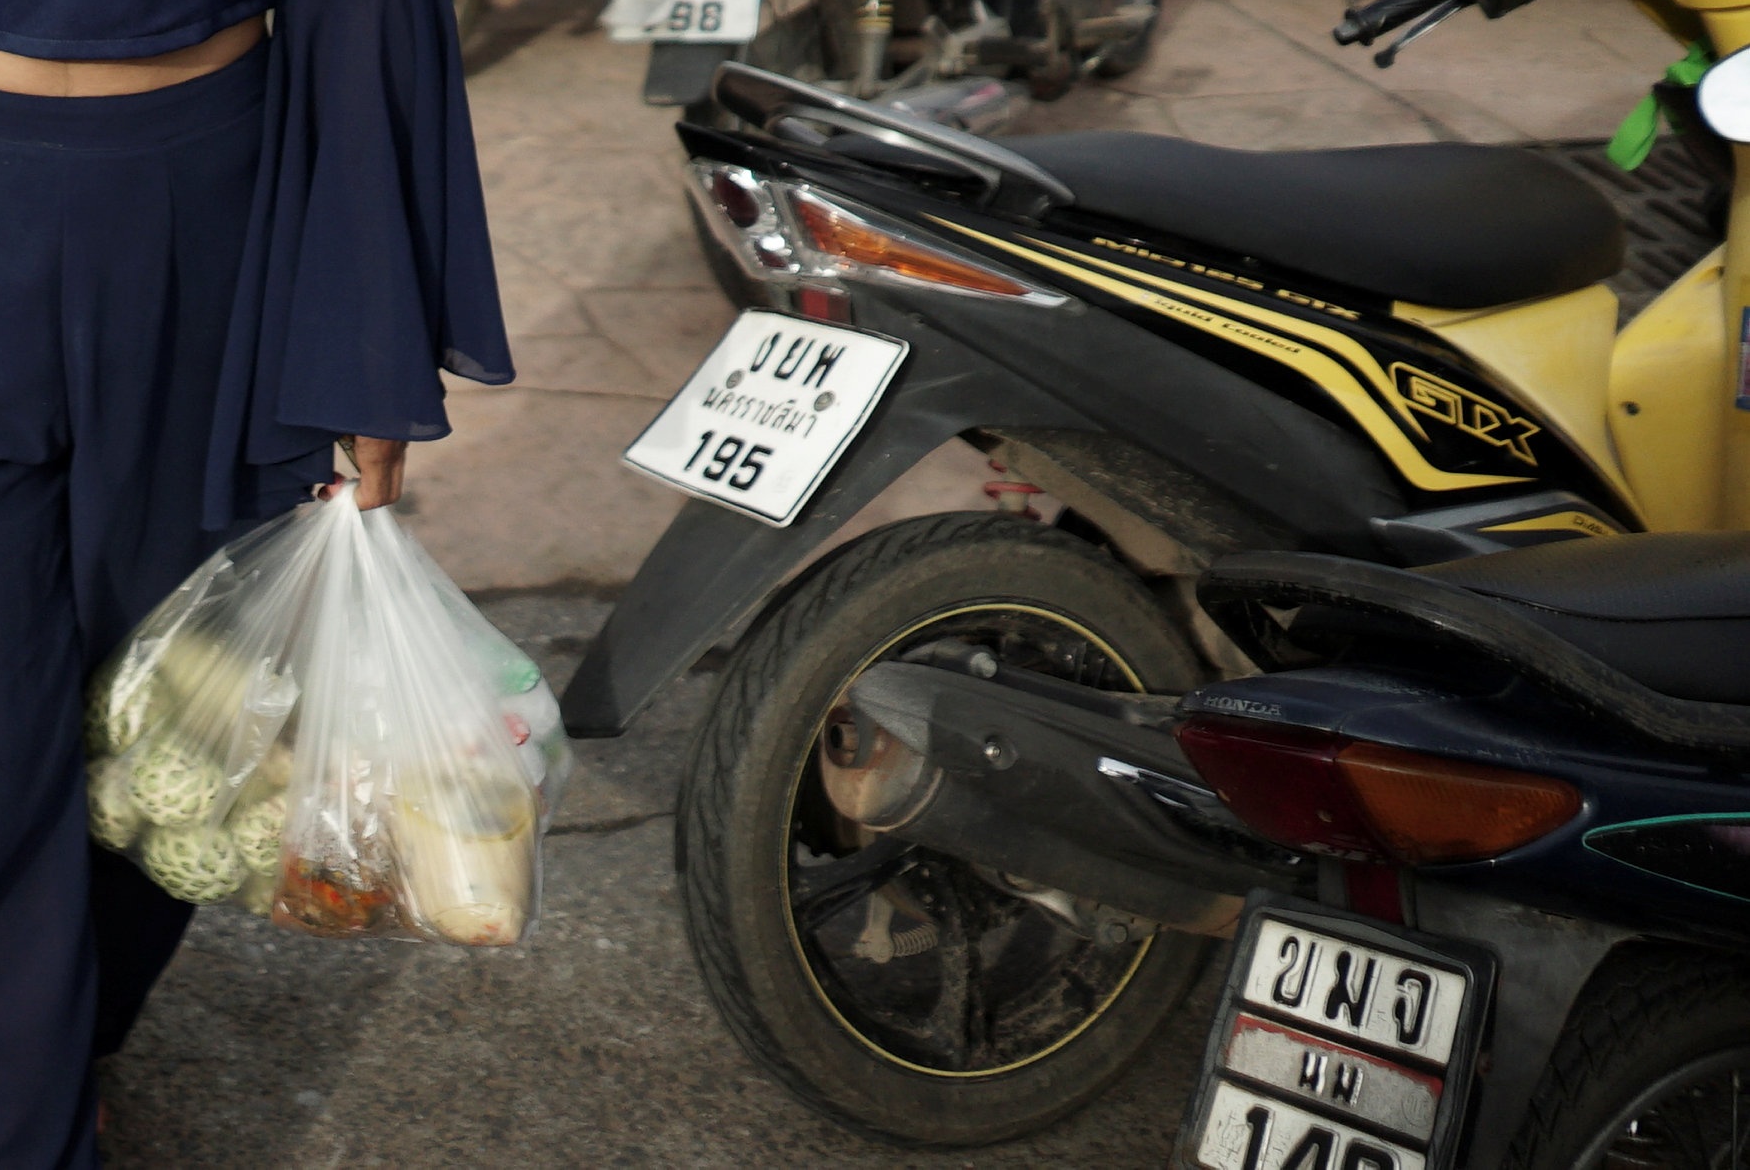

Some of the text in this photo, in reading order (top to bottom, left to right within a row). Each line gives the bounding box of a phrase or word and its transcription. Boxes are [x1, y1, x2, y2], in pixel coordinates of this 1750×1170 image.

[644, 1, 724, 32] 98
[702, 386, 819, 439] นครราชสีมา
[684, 429, 777, 491] 195
